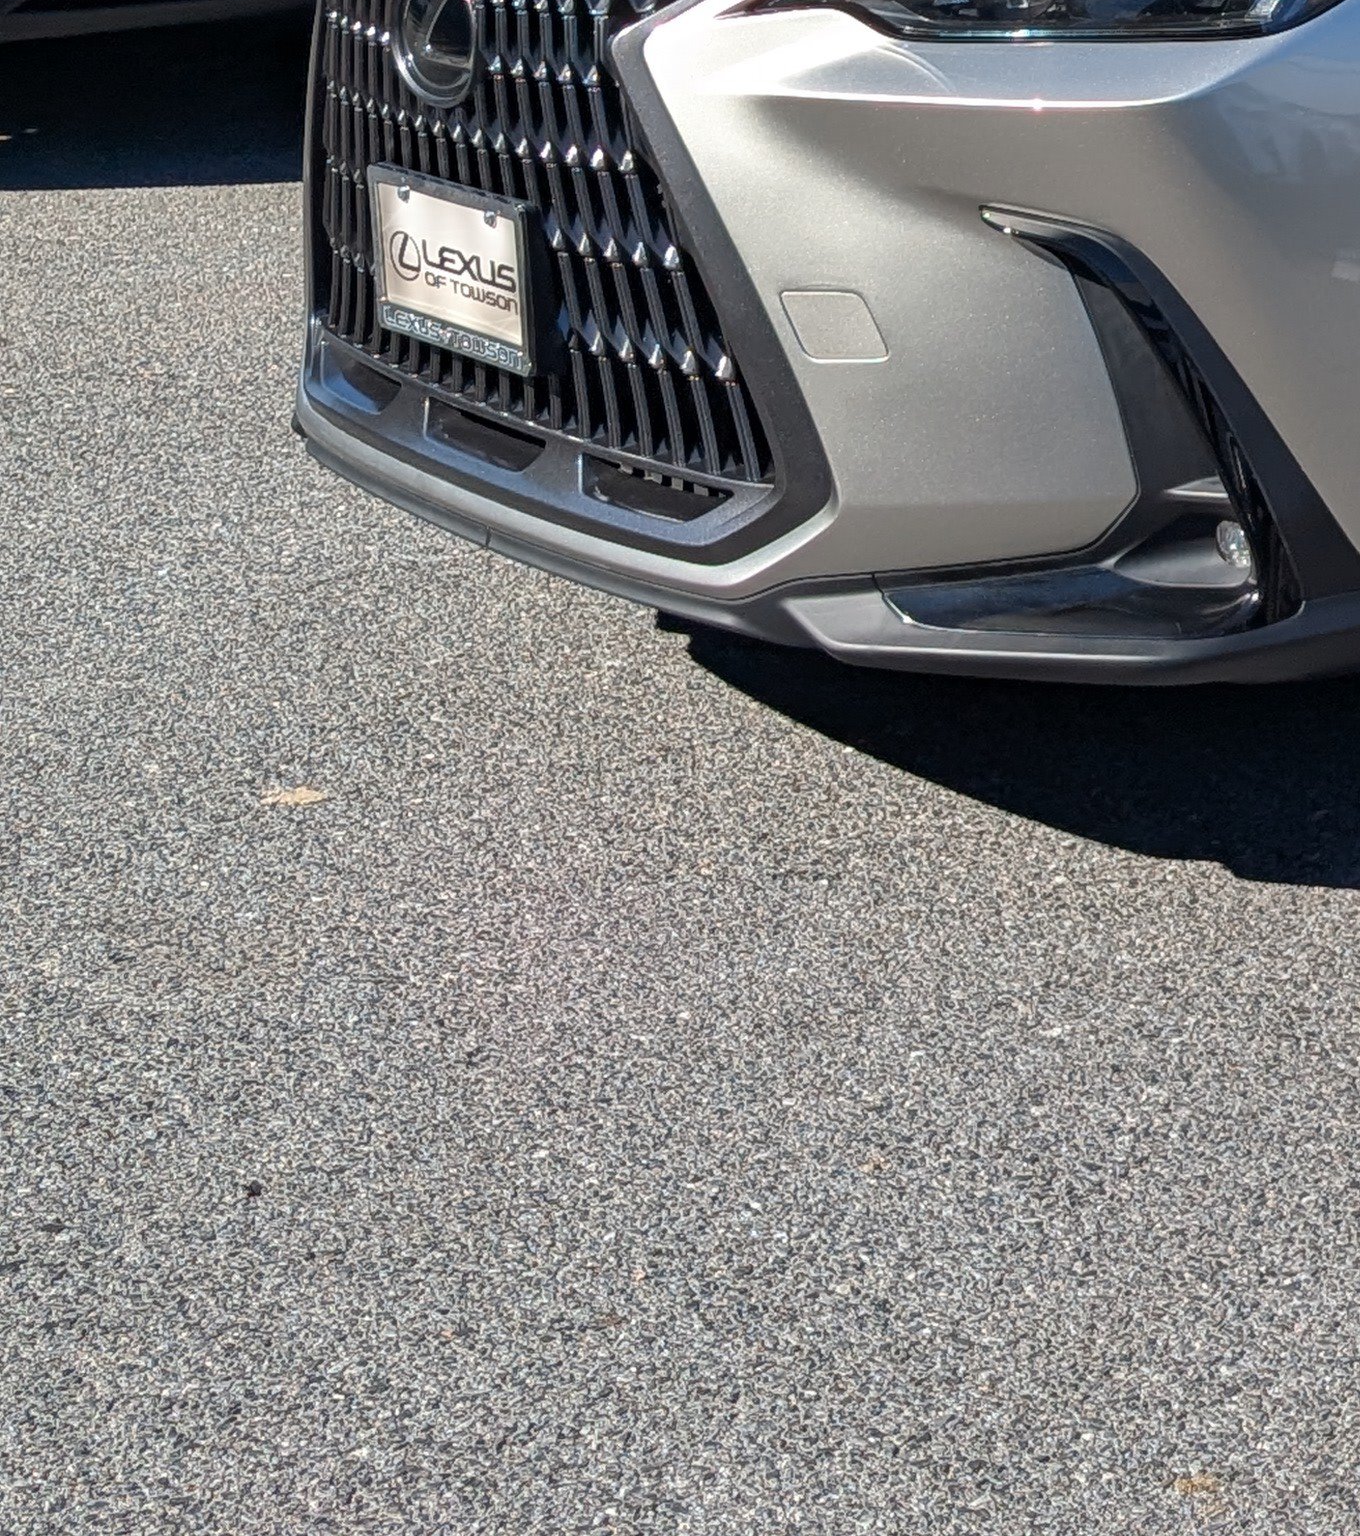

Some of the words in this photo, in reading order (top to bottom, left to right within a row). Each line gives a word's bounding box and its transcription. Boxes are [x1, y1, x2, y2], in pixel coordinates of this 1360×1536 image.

[421, 238, 518, 293] LEXUS
[424, 271, 446, 289] OF
[449, 279, 519, 316] TOWSON
